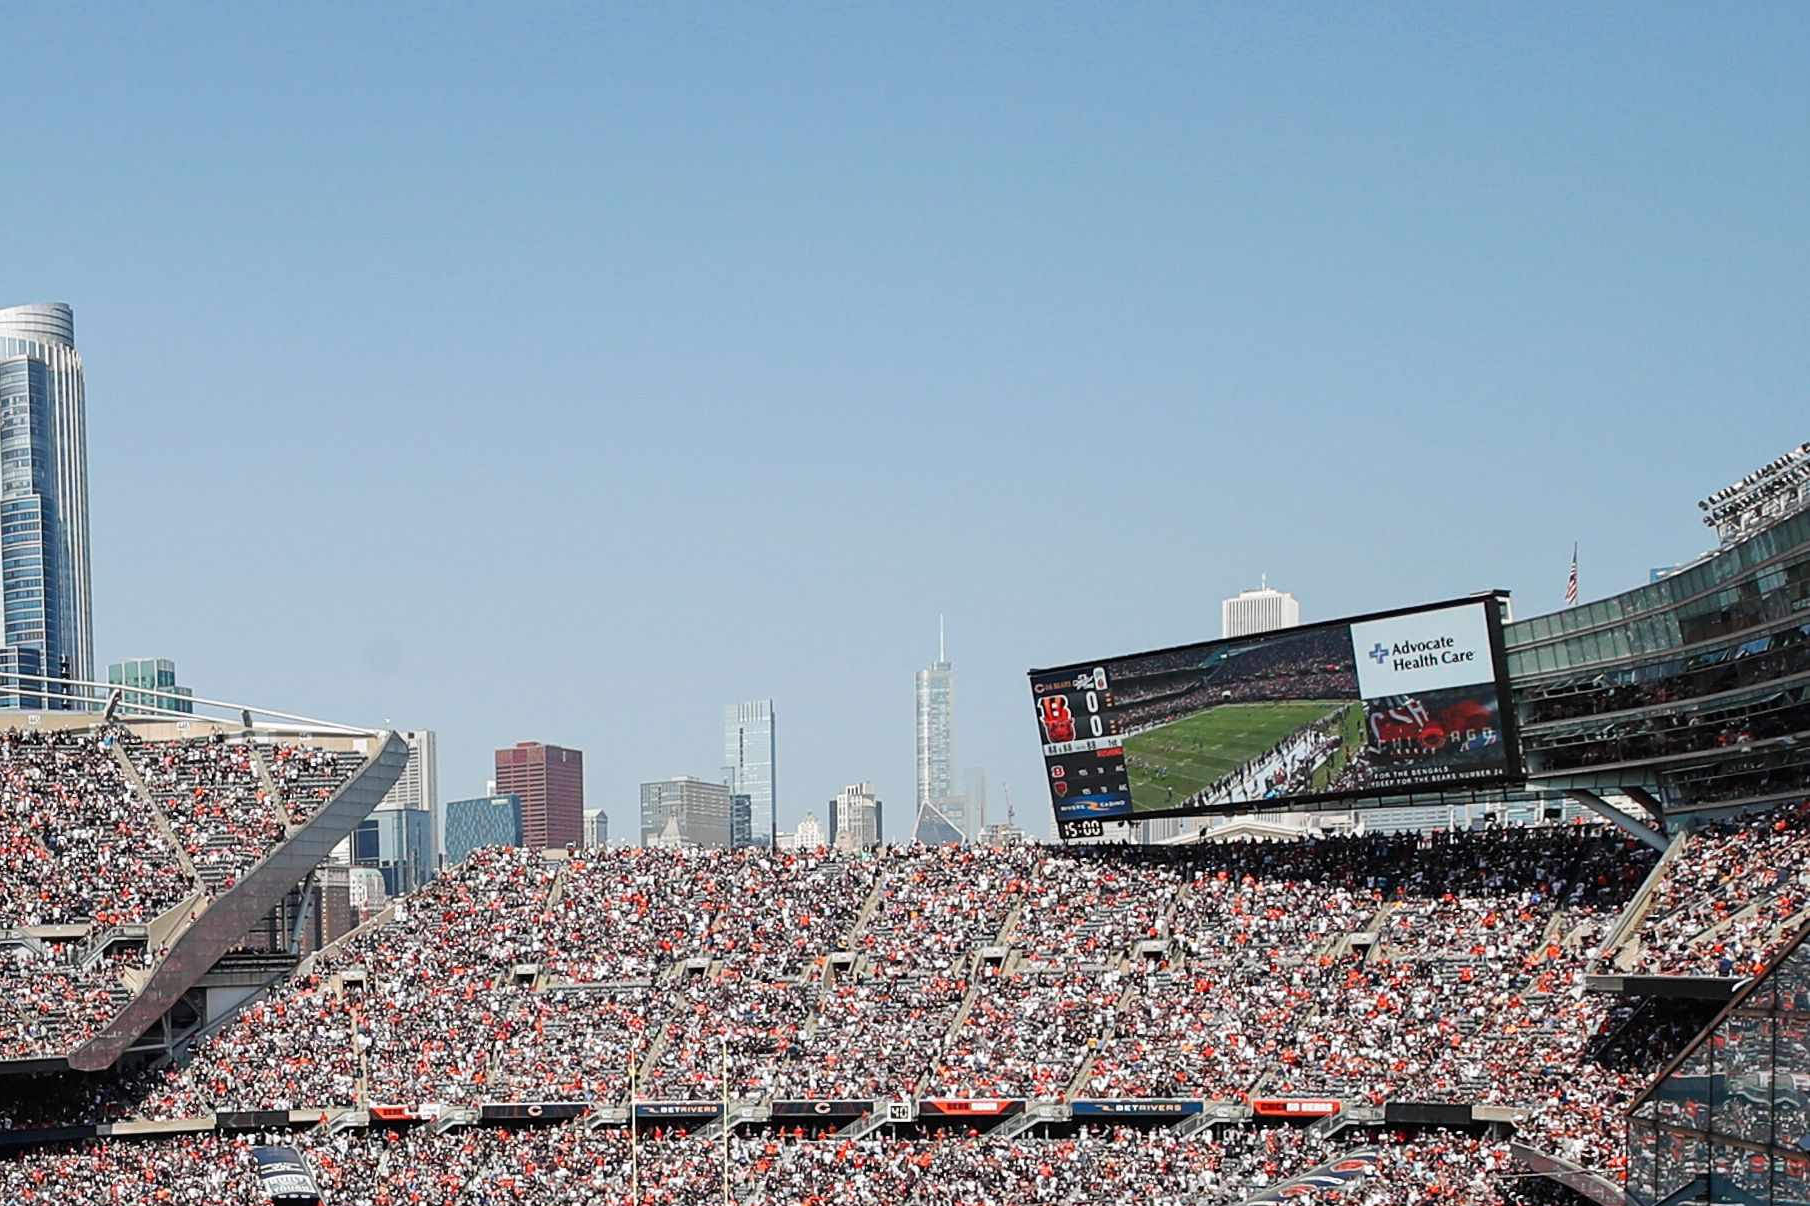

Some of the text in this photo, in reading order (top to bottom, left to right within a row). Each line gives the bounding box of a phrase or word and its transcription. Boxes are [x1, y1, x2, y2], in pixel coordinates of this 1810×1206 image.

[1392, 637, 1454, 656] Advocate
[1394, 650, 1474, 672] Health Care
[1086, 691, 1099, 713] 0
[1090, 715, 1103, 737] 0
[1064, 820, 1101, 838] 15:00
[660, 1106, 718, 1114] BETRIVERS
[890, 1105, 909, 1119] 40
[1115, 1104, 1182, 1112] BETRIVERS
